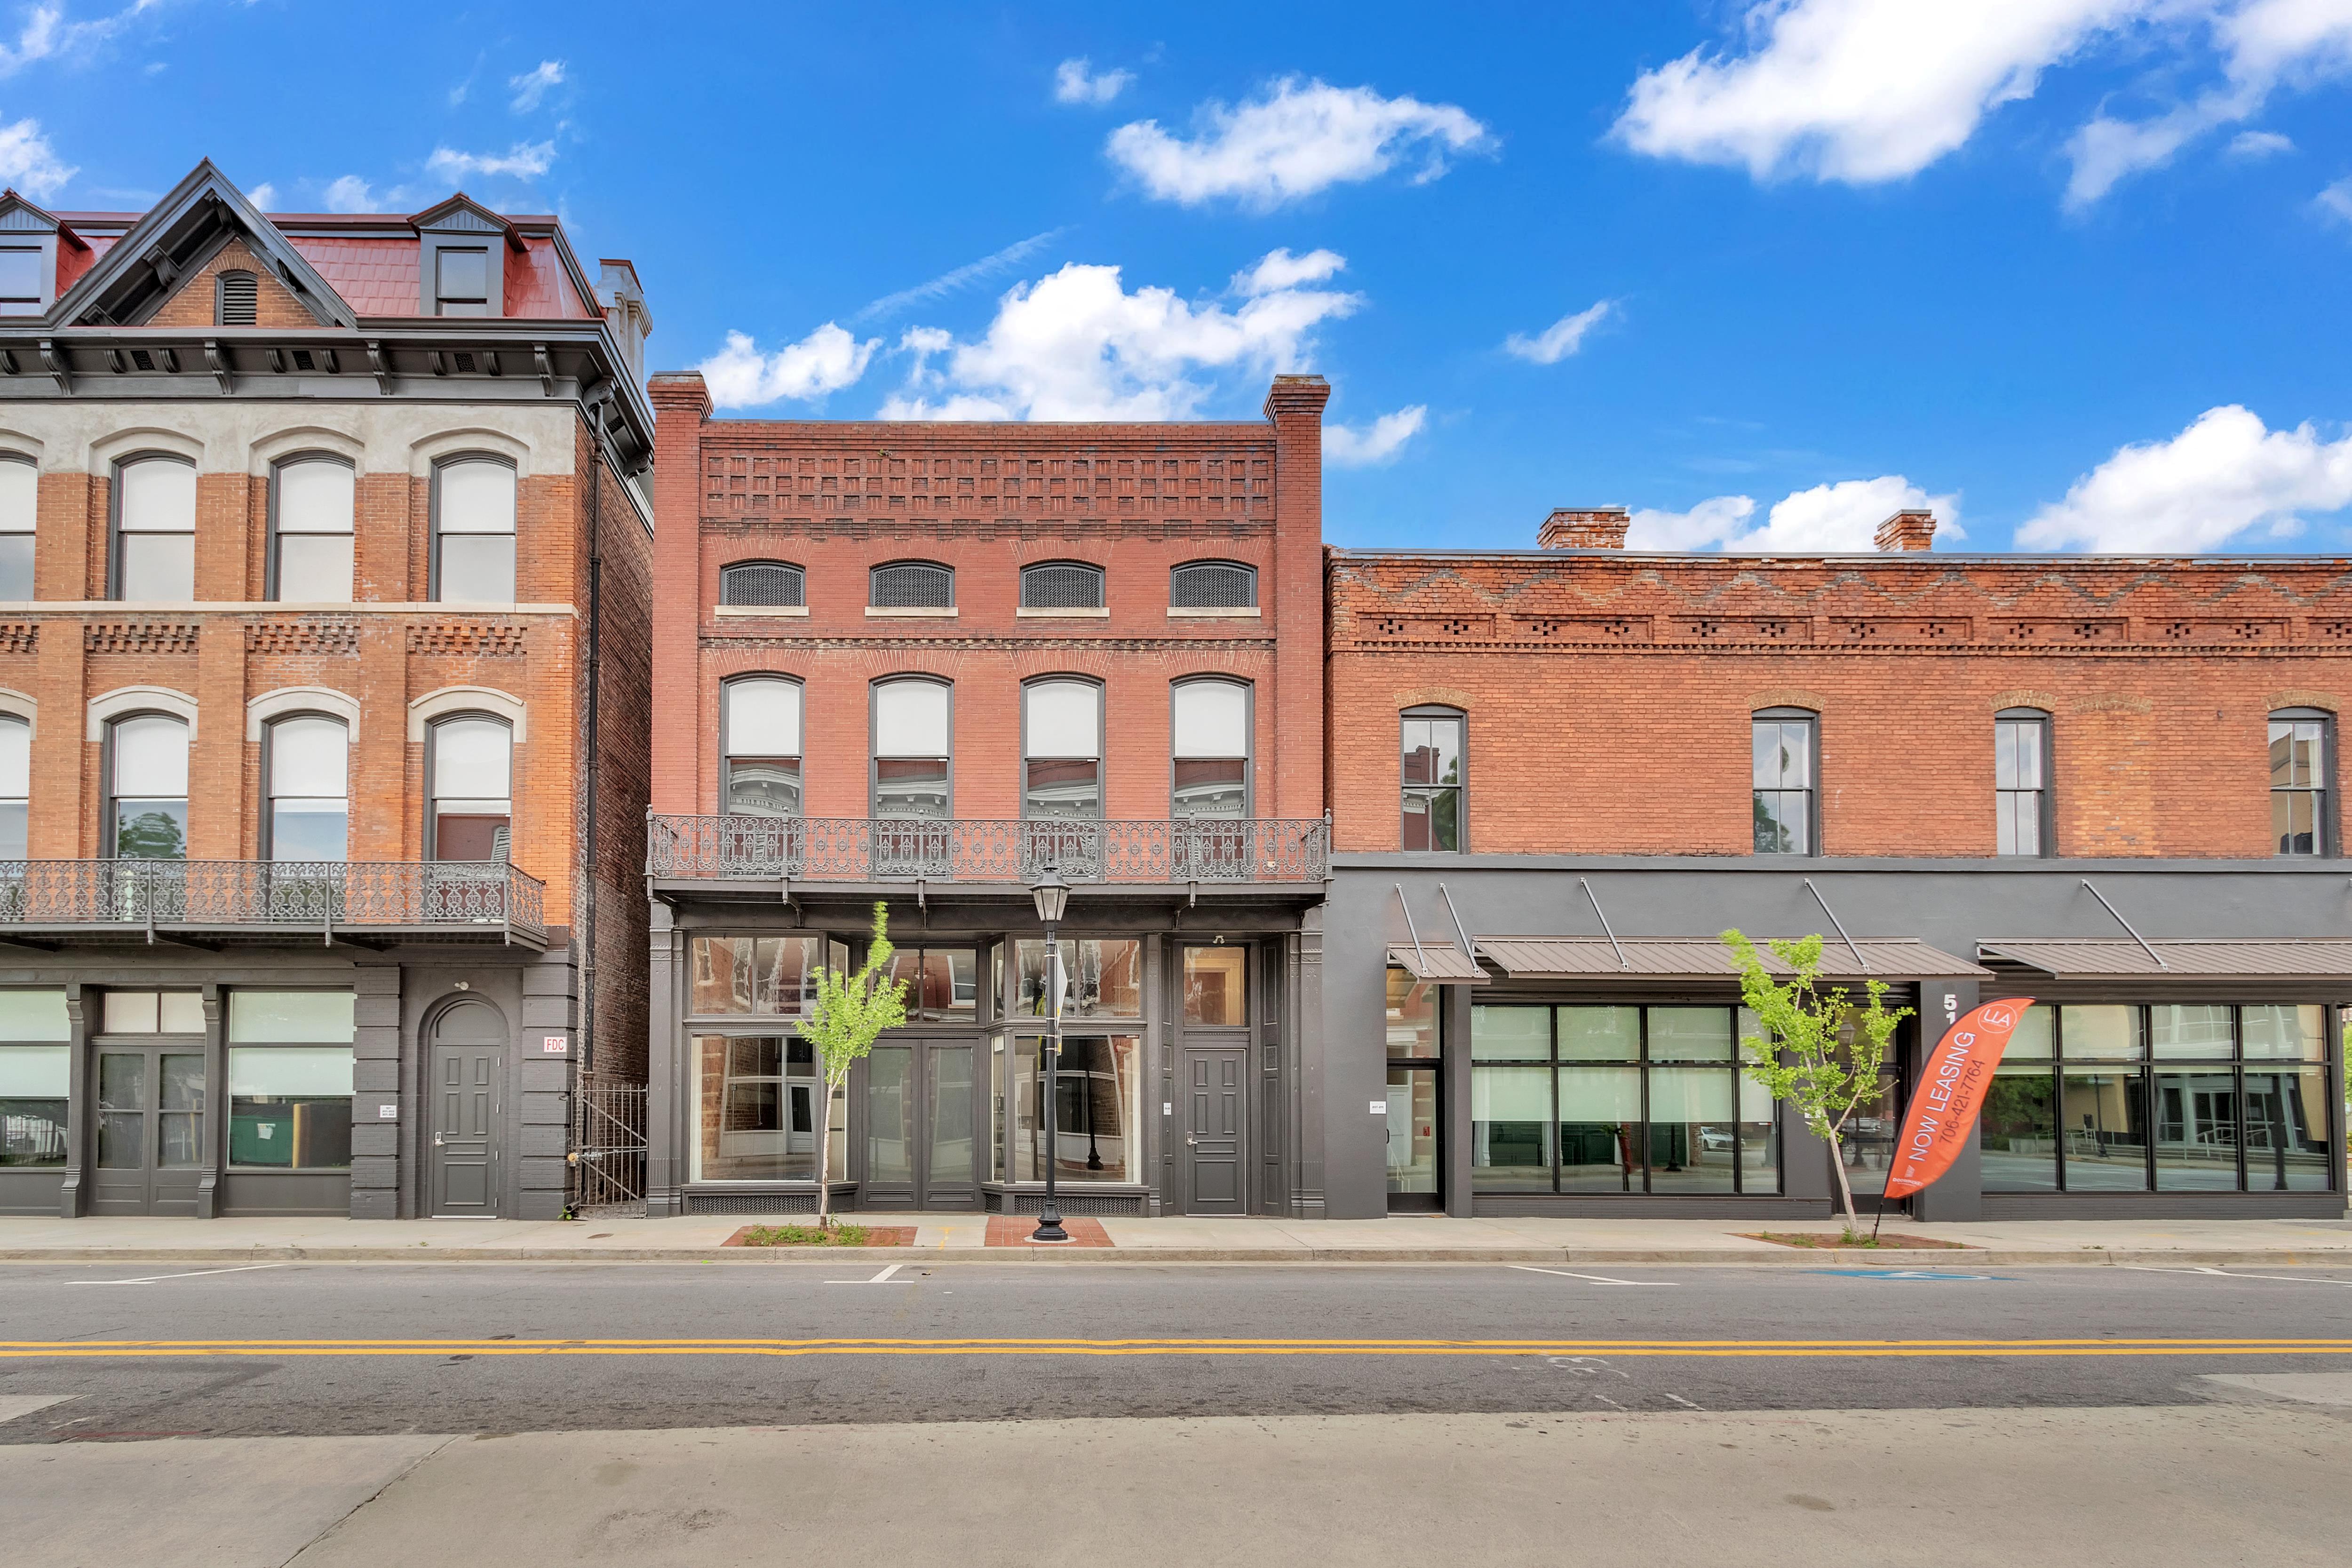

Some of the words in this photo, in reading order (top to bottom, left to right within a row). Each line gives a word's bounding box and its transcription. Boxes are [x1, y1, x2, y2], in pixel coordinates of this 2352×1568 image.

[547, 1039, 564, 1051] FDC
[1908, 1115, 1939, 1162] NOW
[1925, 1032, 1976, 1112] LEASING
[1939, 1059, 1985, 1144] 706-421-7764
